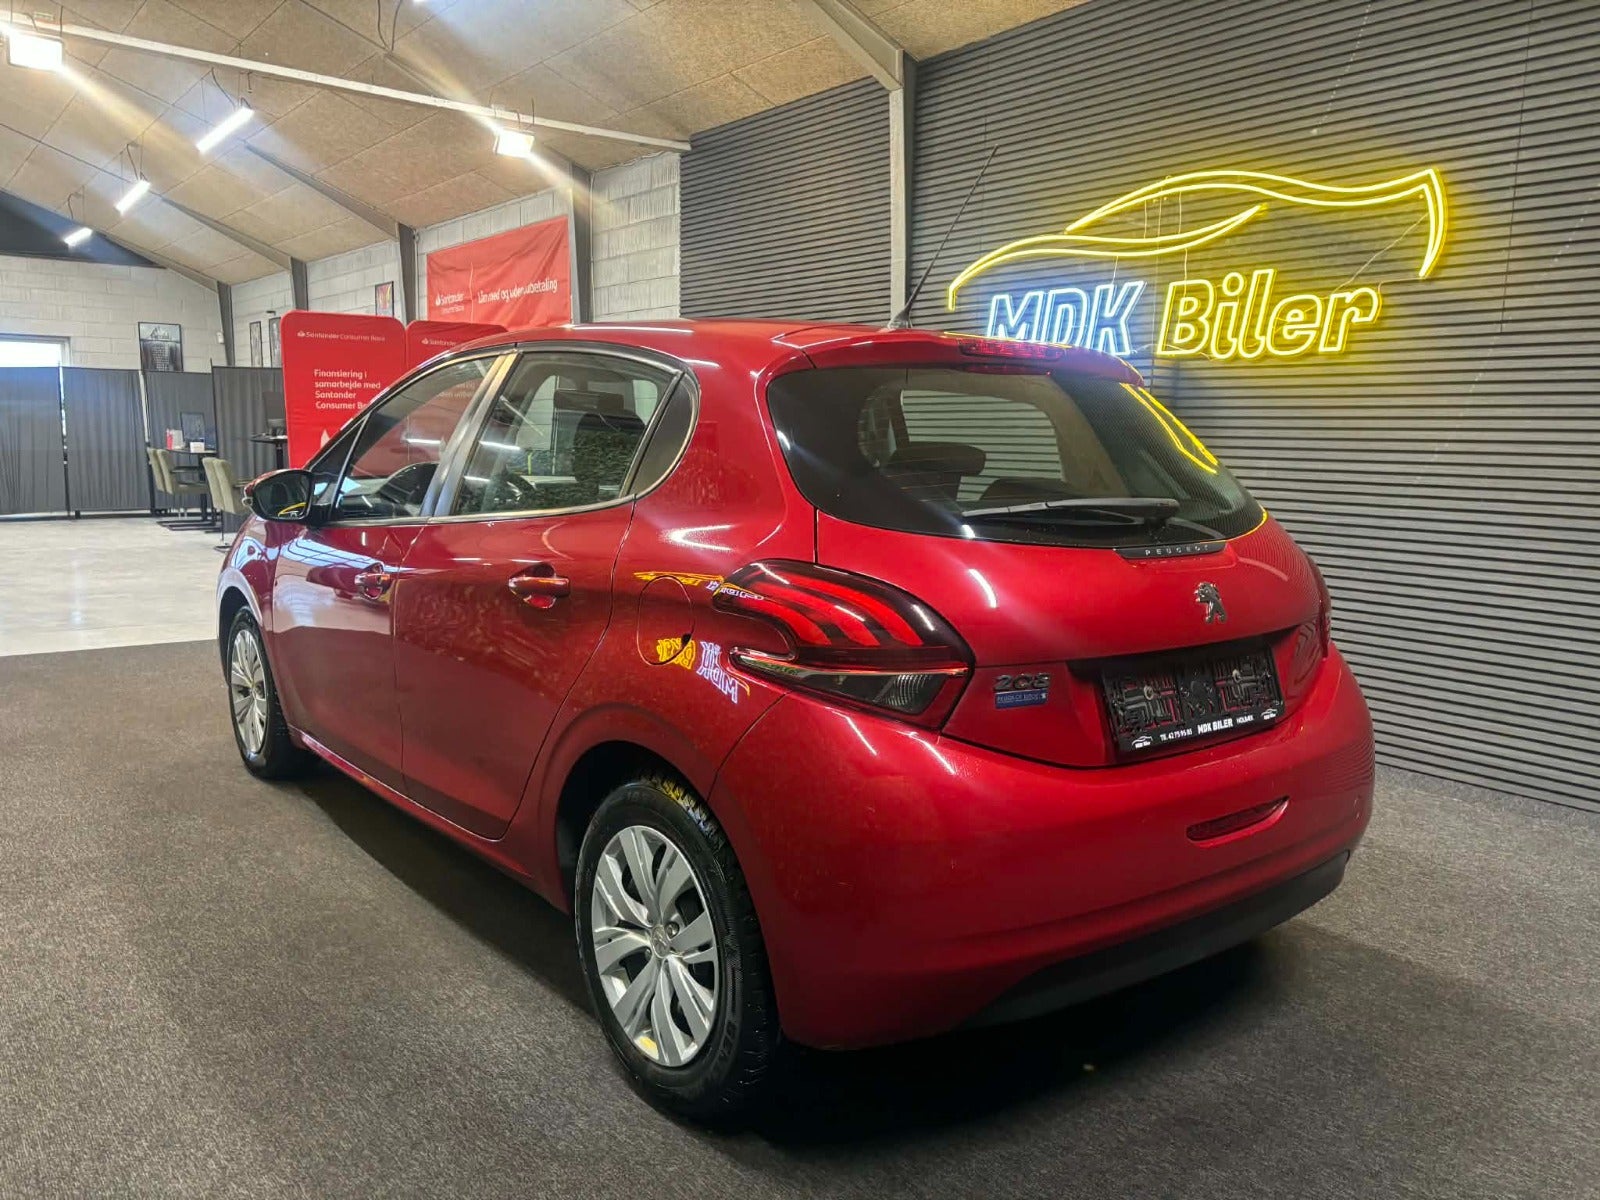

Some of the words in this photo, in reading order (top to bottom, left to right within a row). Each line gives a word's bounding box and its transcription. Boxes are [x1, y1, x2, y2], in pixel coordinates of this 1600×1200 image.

[501, 289, 509, 303] og
[986, 281, 1146, 356] MDK
[1157, 268, 1381, 361] Biler
[306, 331, 340, 340] Santander
[340, 333, 370, 341] Consumer
[313, 368, 363, 380] Finansiering
[314, 380, 362, 390] samarbejde
[363, 381, 381, 389] med
[314, 390, 356, 399] Santander
[315, 400, 356, 410] Consumer
[1144, 544, 1209, 556] PEUGEOT
[994, 673, 1050, 691] 208
[1197, 723, 1212, 735] MDK
[1212, 718, 1233, 731] BILER
